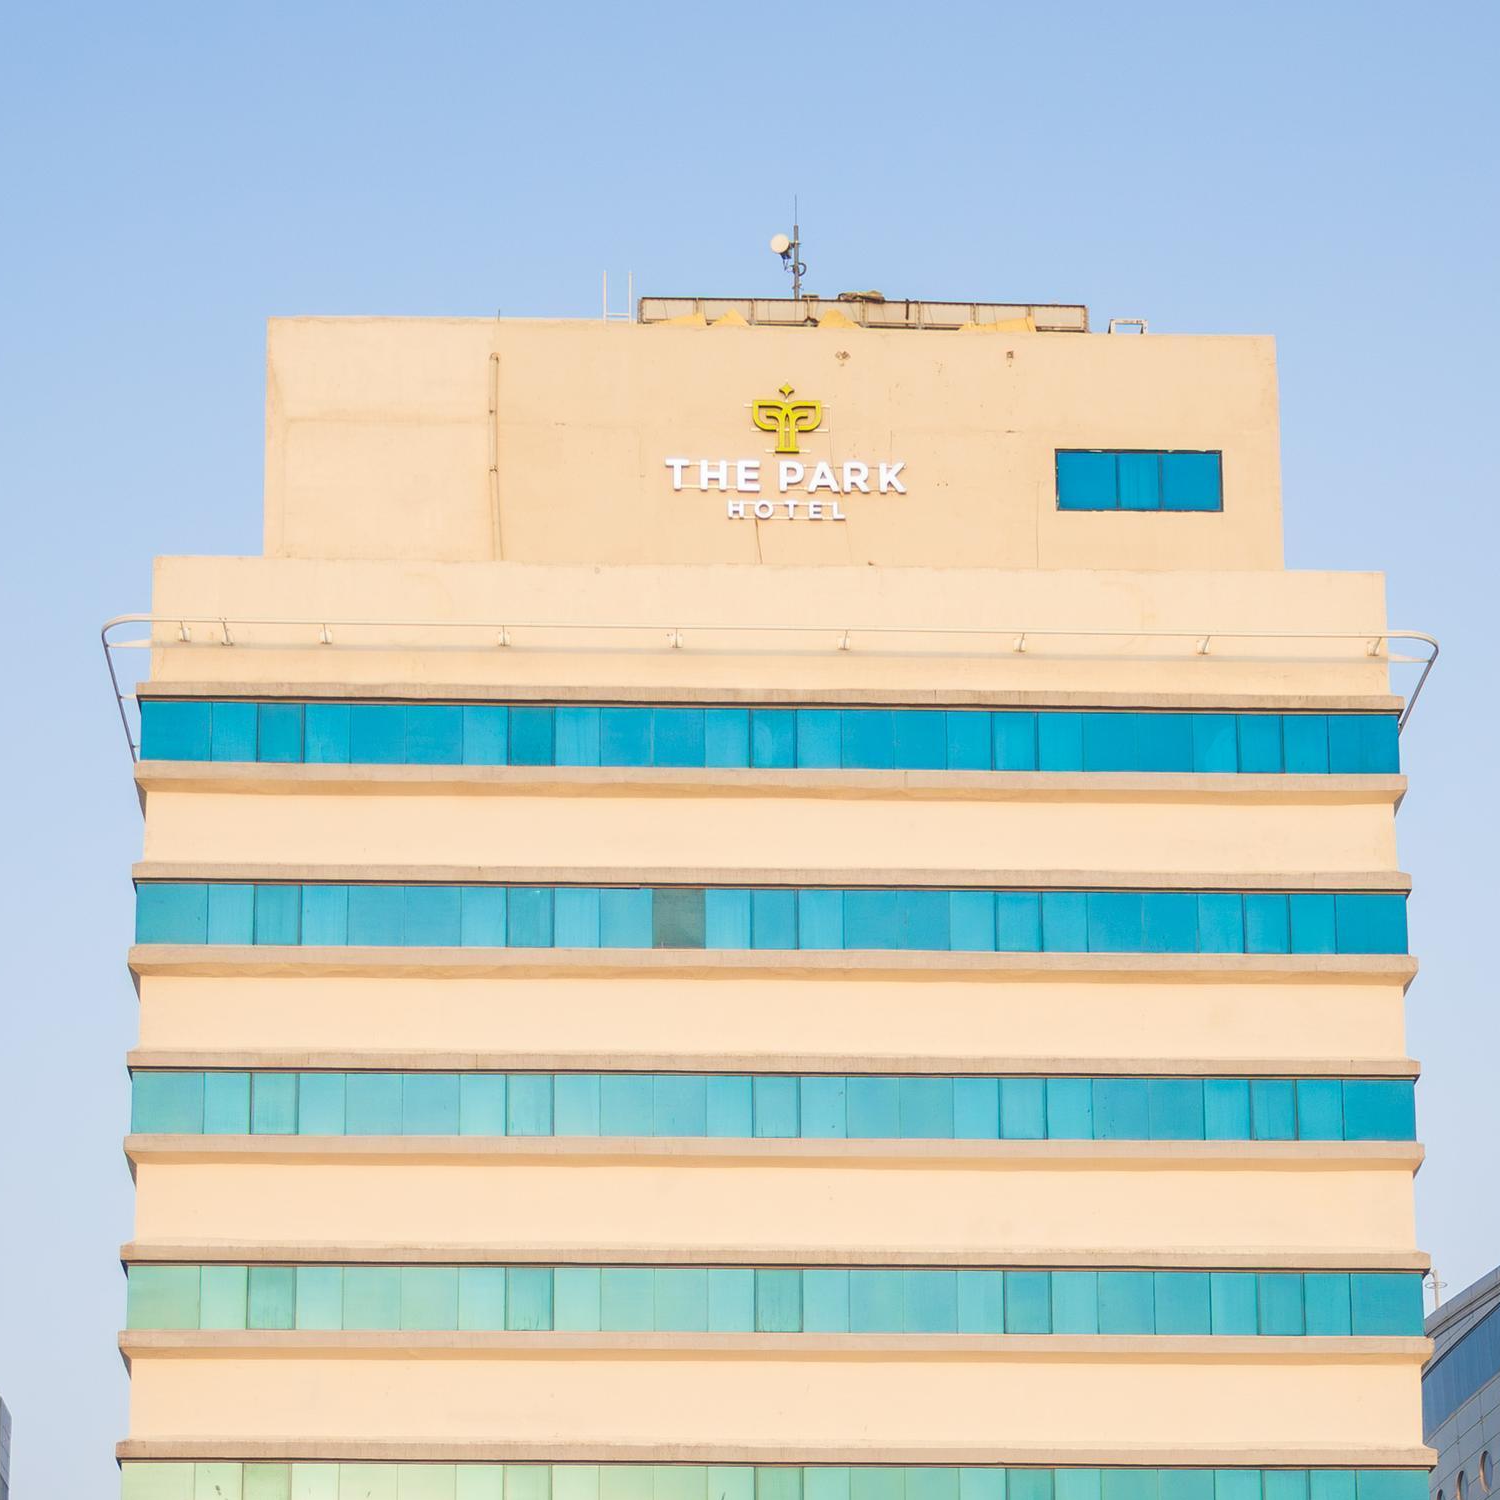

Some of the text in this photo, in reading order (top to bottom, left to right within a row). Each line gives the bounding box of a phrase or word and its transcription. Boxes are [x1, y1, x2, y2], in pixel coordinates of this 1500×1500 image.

[665, 458, 907, 494] THE PARK
[727, 500, 846, 520] HOTEL
